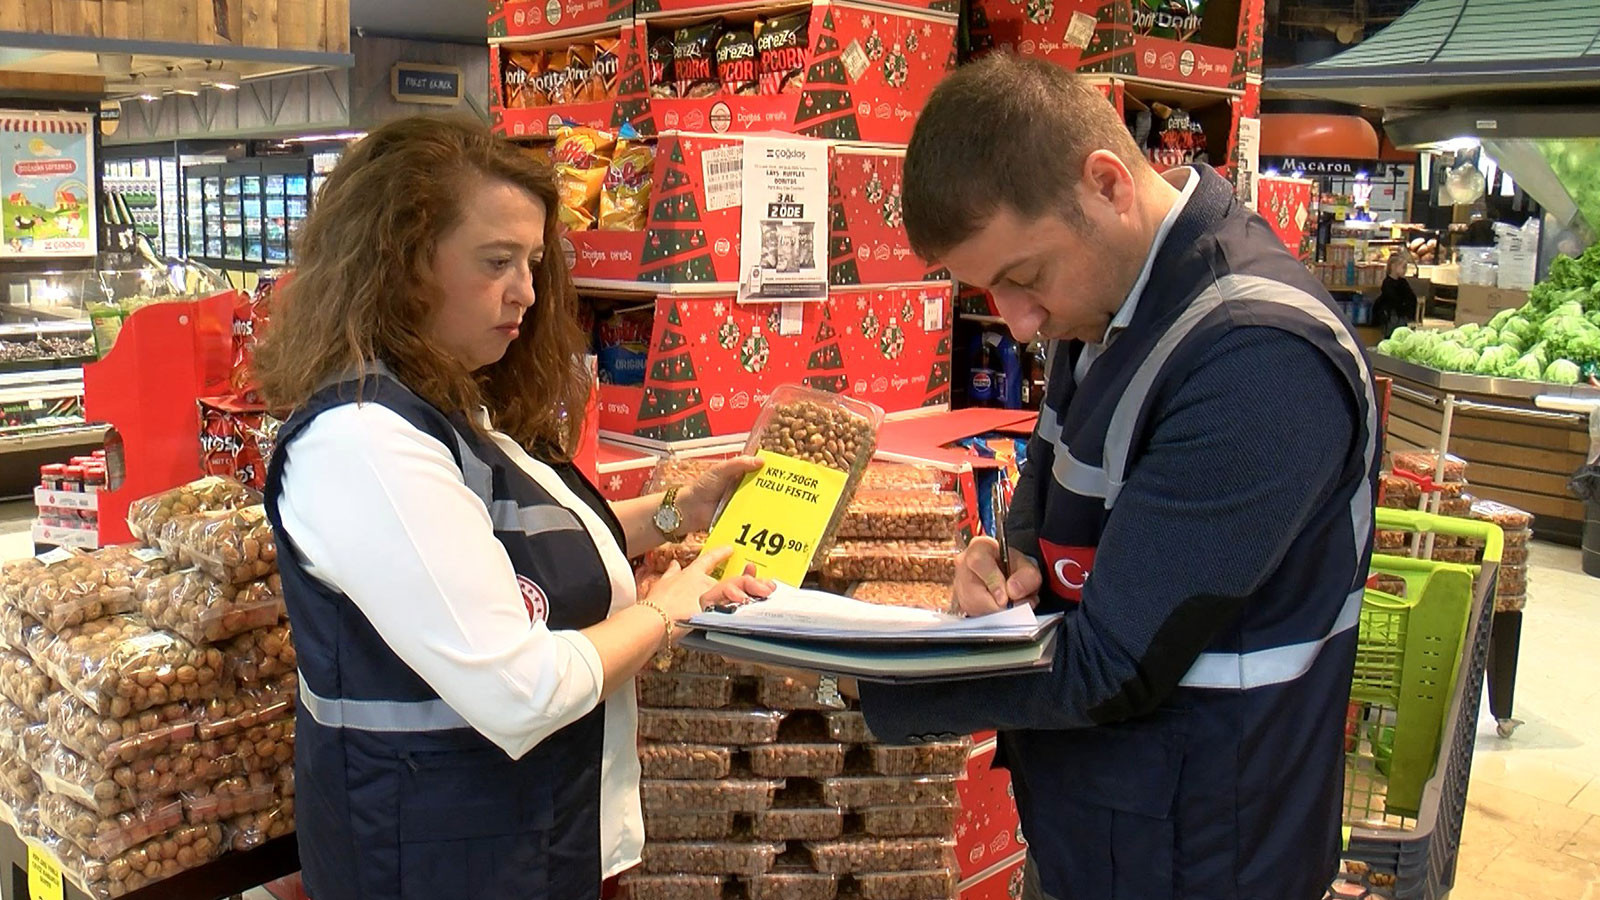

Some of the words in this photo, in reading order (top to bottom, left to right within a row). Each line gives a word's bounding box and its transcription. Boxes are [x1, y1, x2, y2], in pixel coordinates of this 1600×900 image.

[1282, 157, 1352, 173] Macaron
[778, 193, 783, 203] 3
[784, 194, 795, 203] AL
[771, 206, 778, 218] 2
[615, 358, 646, 370] ORIGIN
[755, 477, 785, 493] TUZLU
